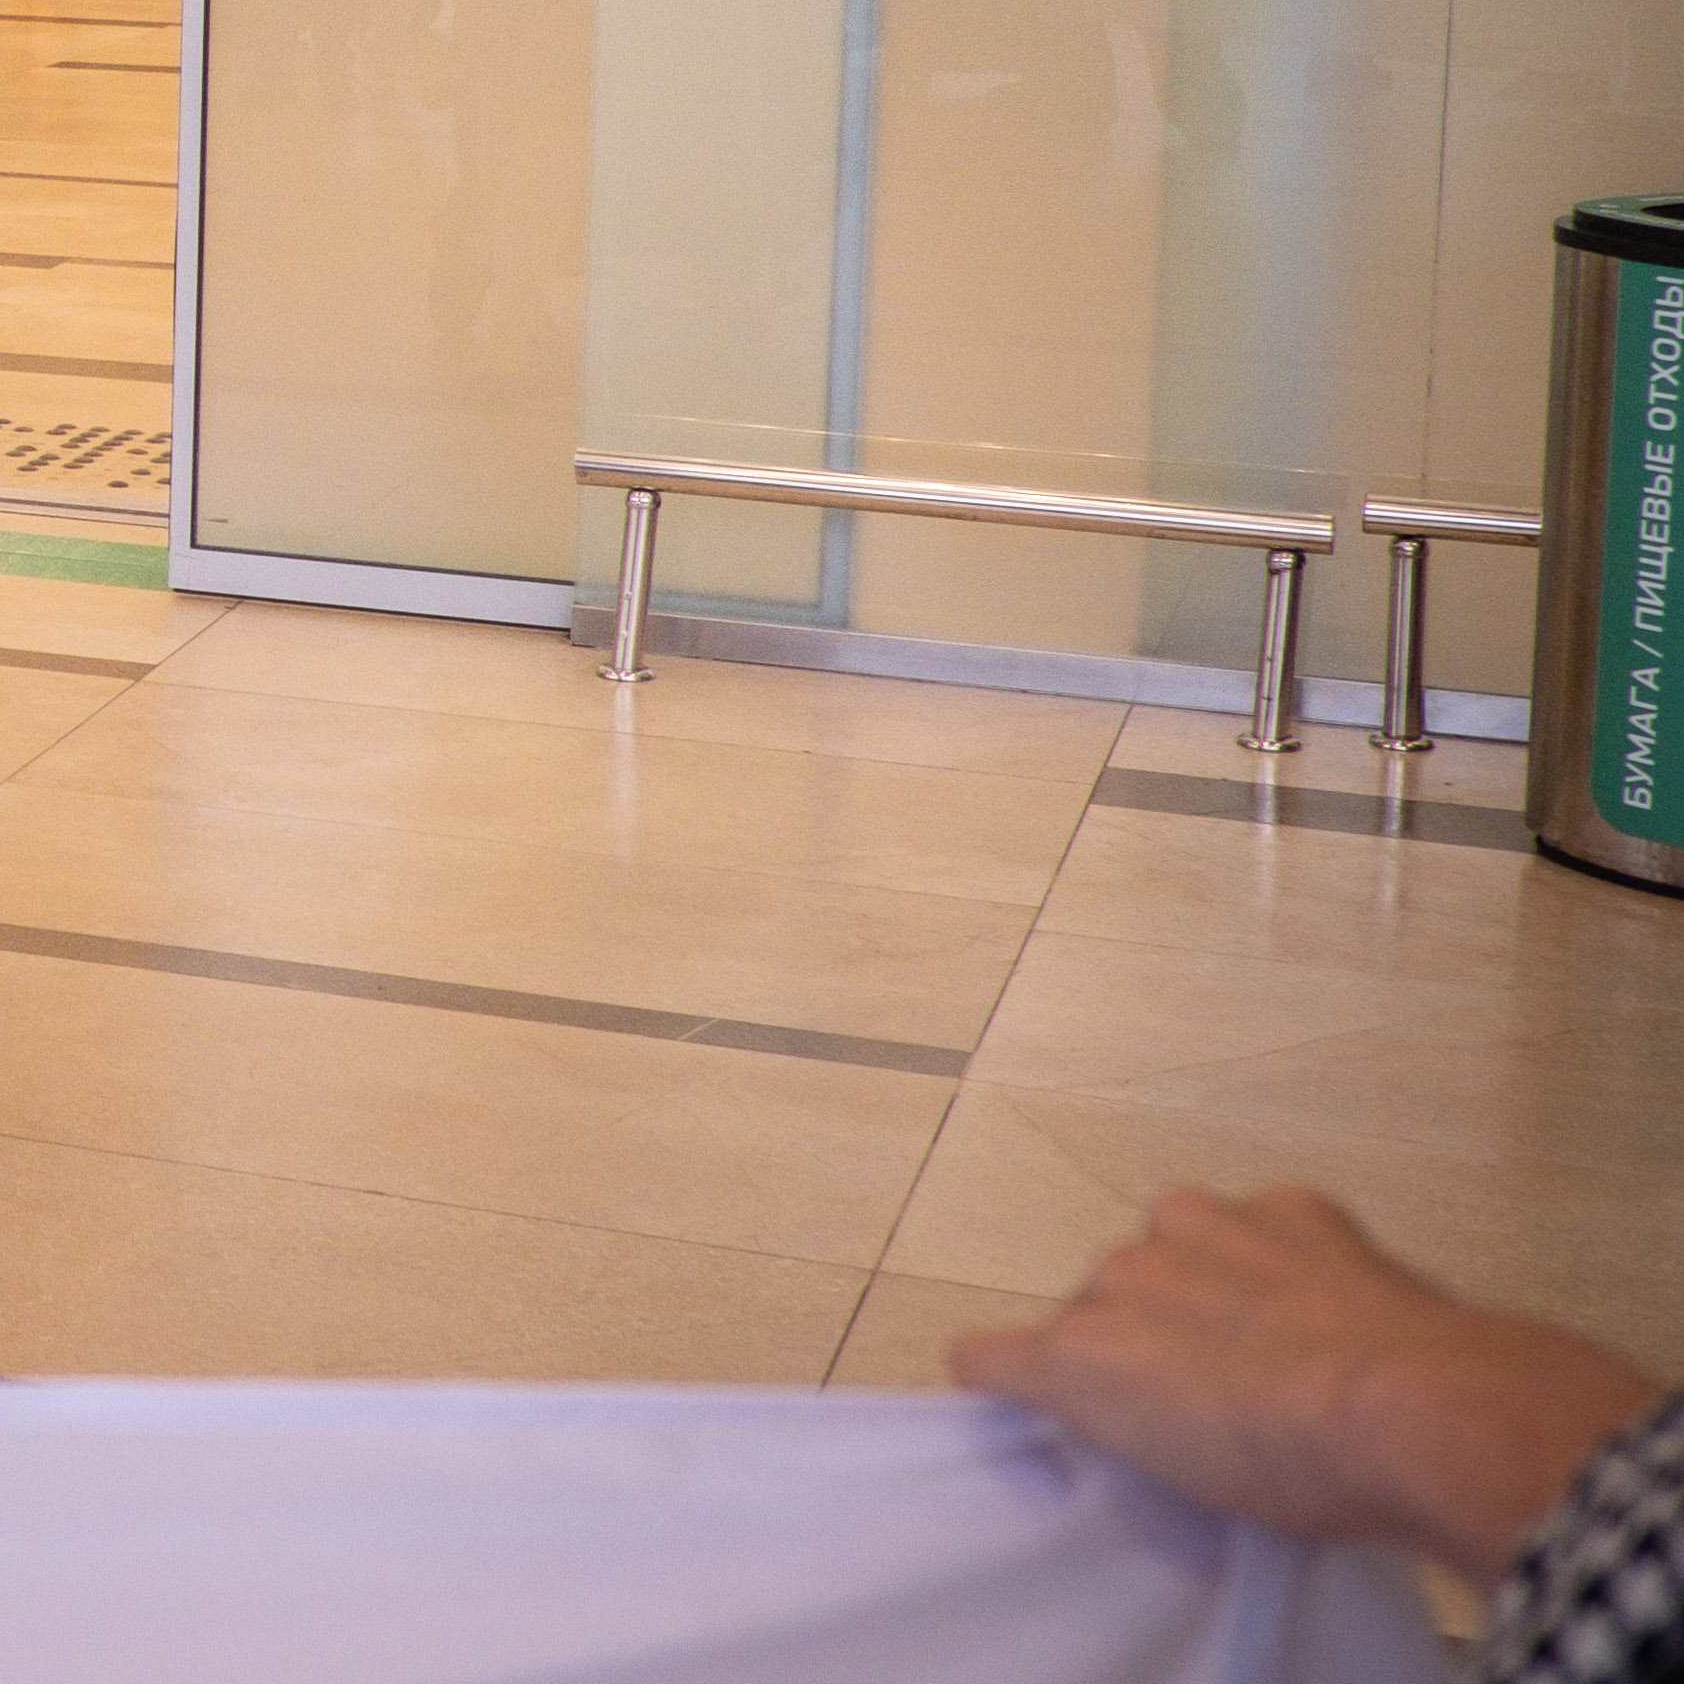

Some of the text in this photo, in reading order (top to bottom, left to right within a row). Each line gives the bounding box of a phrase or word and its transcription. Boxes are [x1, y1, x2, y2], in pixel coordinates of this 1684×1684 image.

[1646, 275, 1684, 431] ОТХОДЫ
[1633, 441, 1677, 633] ПИЩЕВЫЕ
[1621, 666, 1662, 812] БУМАГА
